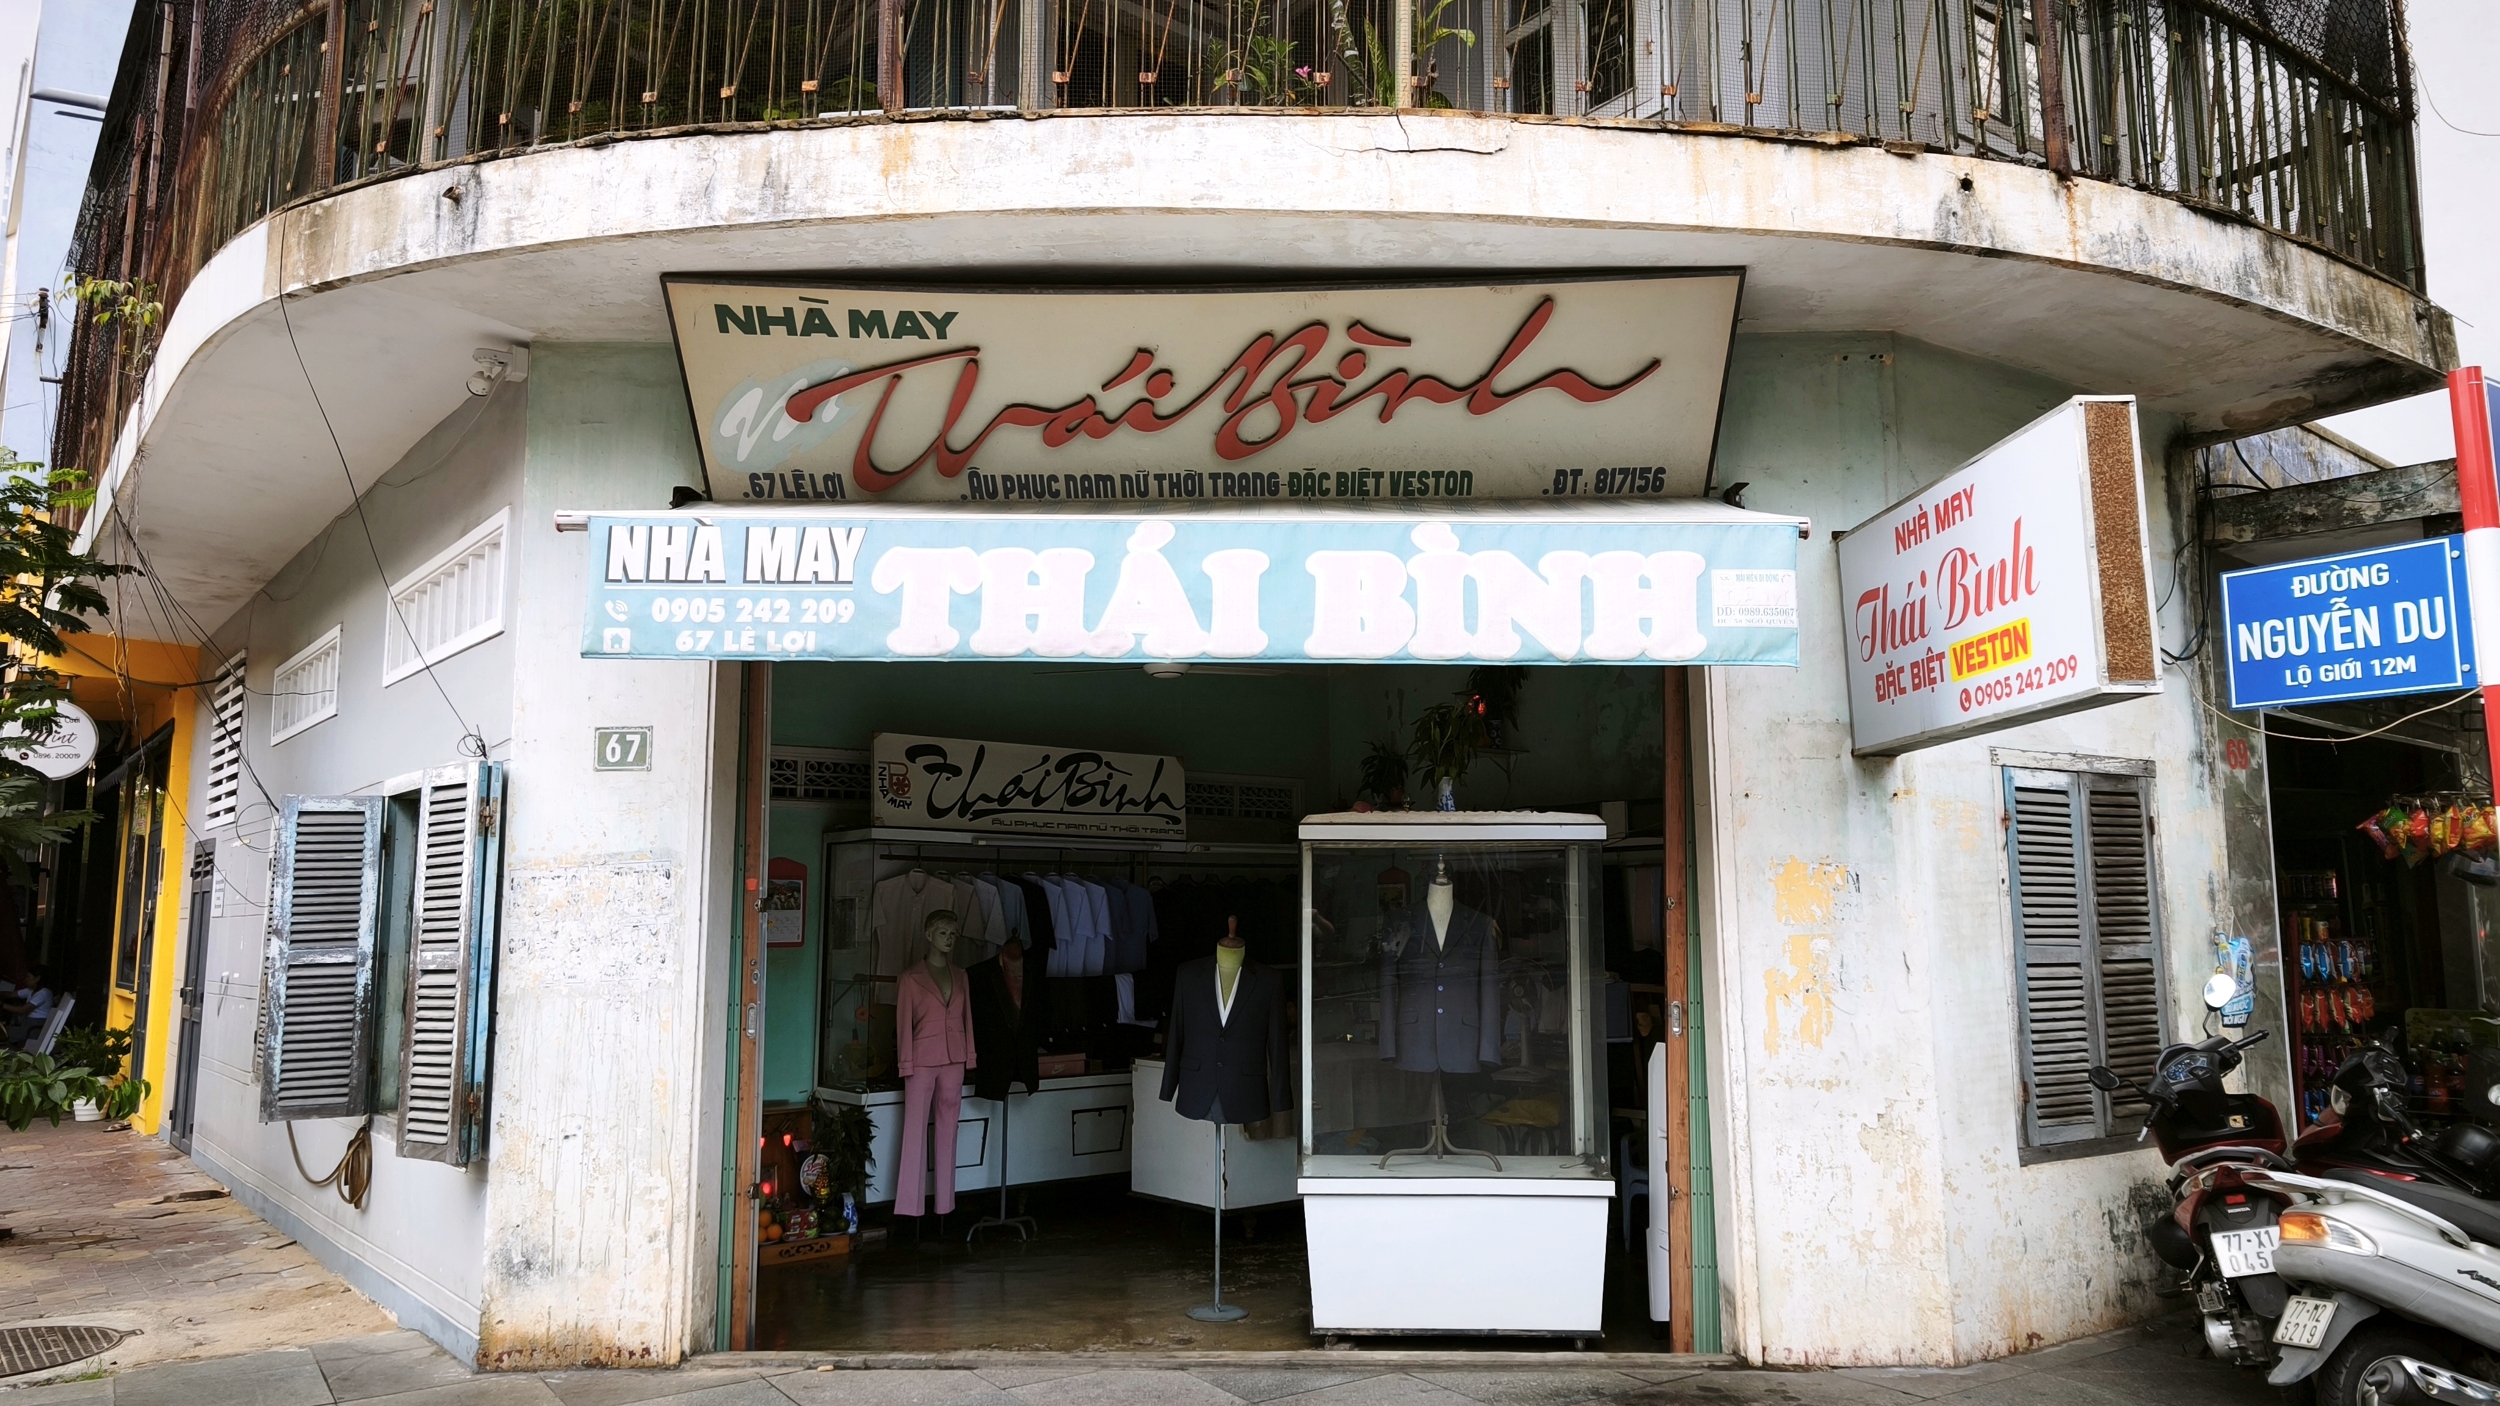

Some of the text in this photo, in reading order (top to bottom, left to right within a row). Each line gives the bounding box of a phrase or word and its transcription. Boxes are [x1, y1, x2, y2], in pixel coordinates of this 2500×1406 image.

[714, 296, 959, 340] NHÀ MAY
[786, 295, 1661, 492] Thái Bình
[779, 469, 809, 499] LÊ
[1064, 474, 1117, 499] NAM
[1120, 470, 1149, 498] NỮ
[1154, 470, 1204, 498] THỜI
[1336, 467, 1385, 501] BIỆT
[1389, 470, 1474, 497] VESTON
[1594, 467, 1667, 494] 817156
[1894, 483, 1975, 555] NHÀ MAY
[605, 517, 868, 585] NHÀ MAY
[871, 520, 1707, 660] THÁI BÌNH
[1855, 515, 2040, 662] Thái Bình
[2290, 563, 2390, 598] ĐƯỜNG
[651, 597, 856, 624] 0905 242 209
[675, 626, 817, 658] 67 LÊ LỢI
[2237, 596, 2447, 662] NGUYỄN DU
[1875, 622, 2030, 705] ĐẶC BIỆT VESTON
[1975, 654, 2077, 707] 0905 242 209
[2285, 655, 2417, 688] LỘ GIỚI 12M
[605, 734, 641, 763] 67
[2225, 738, 2249, 770] 69
[1054, 752, 1187, 813] Bình
[887, 797, 912, 809] MAY
[2222, 1229, 2275, 1252] 77-X1
[2229, 1251, 2270, 1273] 045
[2281, 1321, 2318, 1344] 5219
